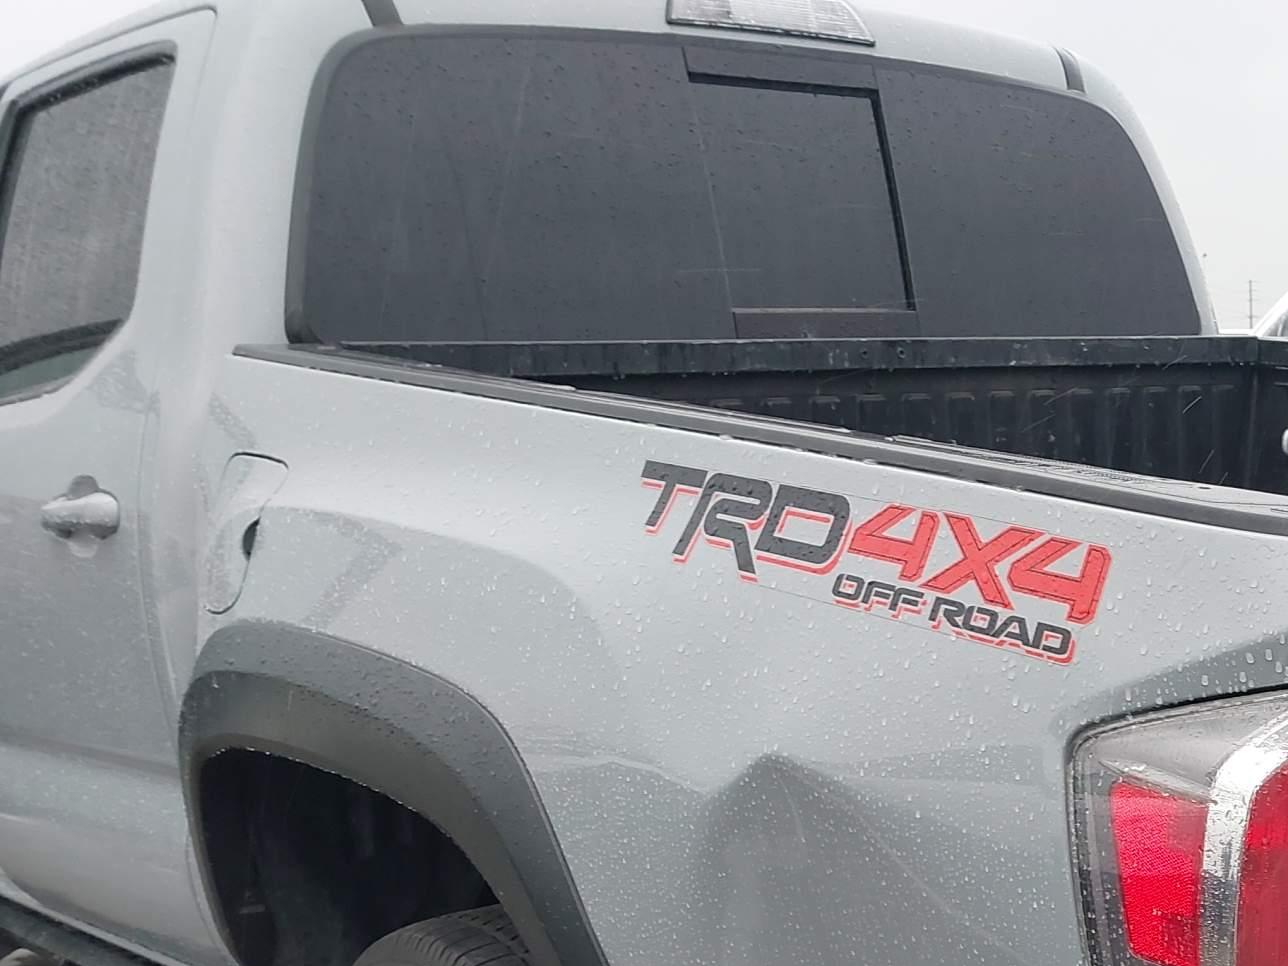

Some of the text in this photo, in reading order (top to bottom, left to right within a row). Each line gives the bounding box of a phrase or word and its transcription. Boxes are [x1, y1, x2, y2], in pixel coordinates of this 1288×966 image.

[641, 460, 1113, 625] TRD 4X4
[832, 572, 1077, 665] OFF ROAD
